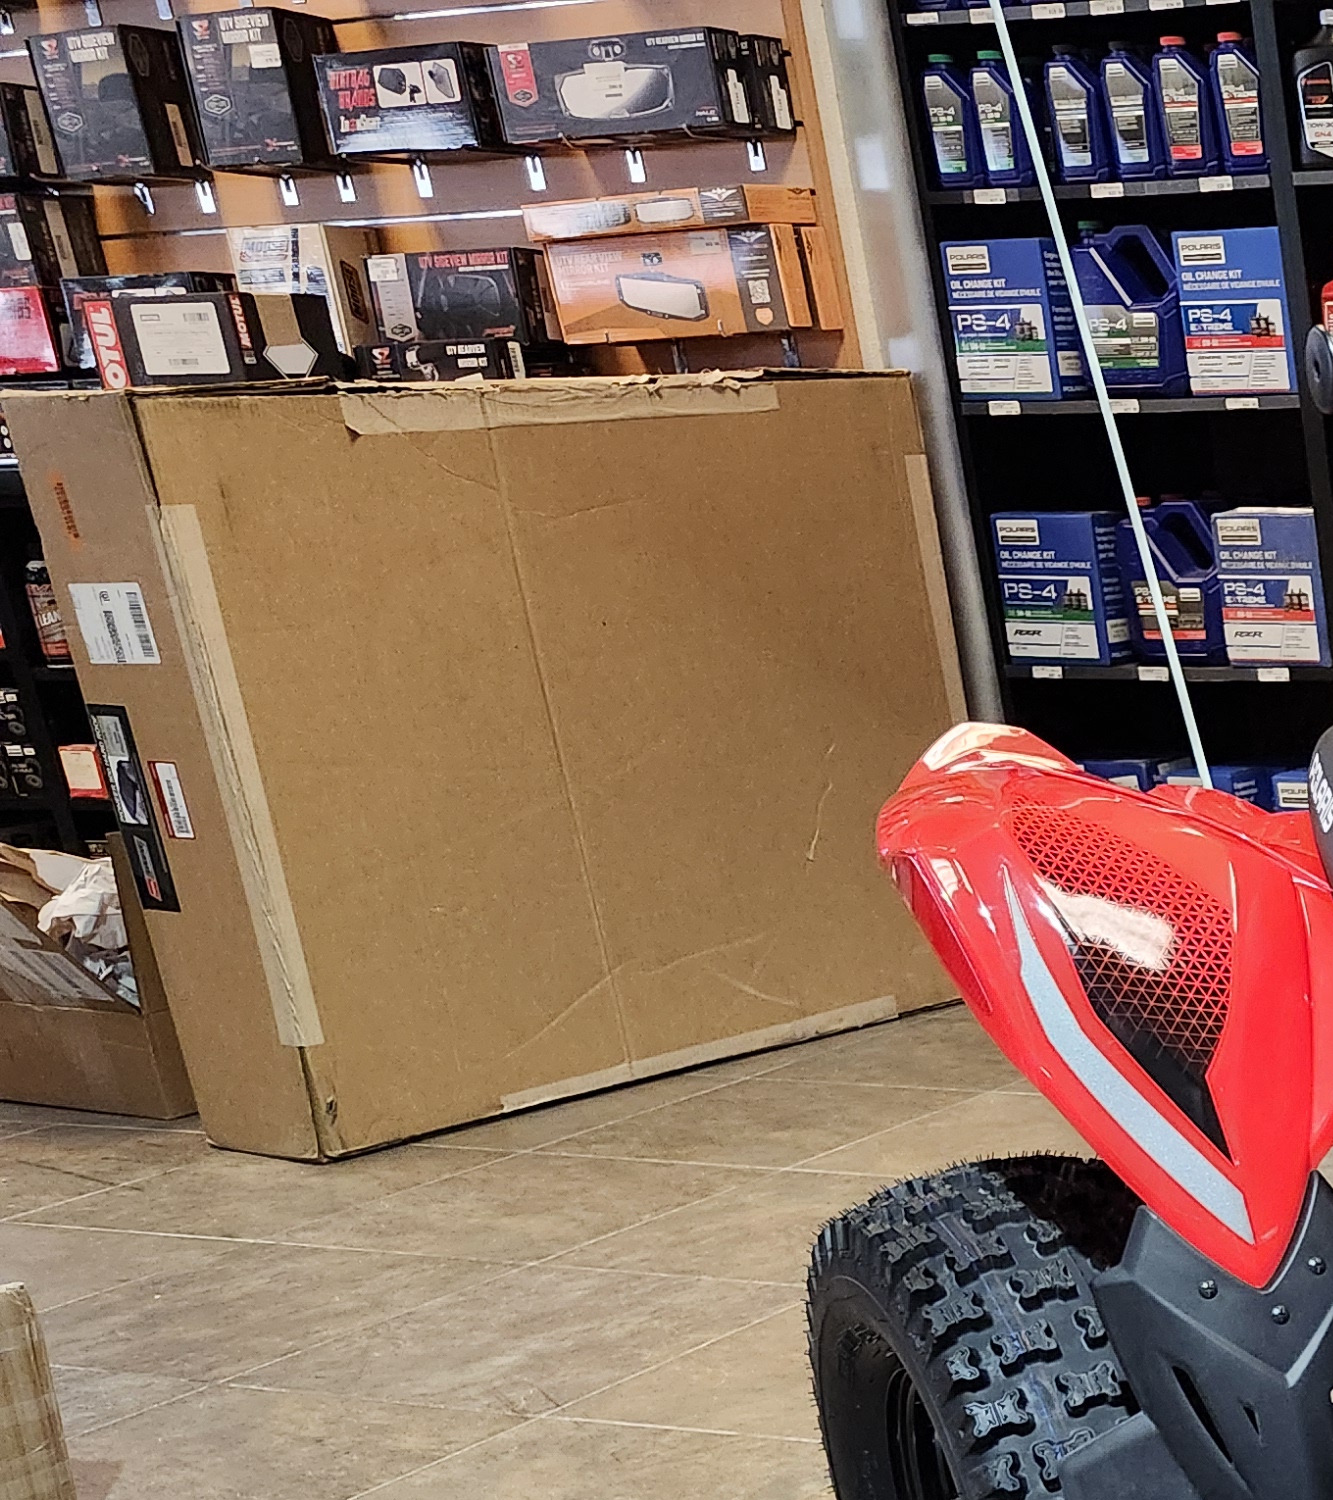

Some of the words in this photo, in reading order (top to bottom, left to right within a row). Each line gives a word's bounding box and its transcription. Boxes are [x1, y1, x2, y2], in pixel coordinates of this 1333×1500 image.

[957, 313, 1011, 331] PS-4
[1188, 308, 1232, 322] PS-4
[1089, 318, 1128, 331] PS-4
[90, 304, 128, 389] OTUL
[1003, 582, 1058, 599] PS-4
[1223, 582, 1265, 596] PS-4
